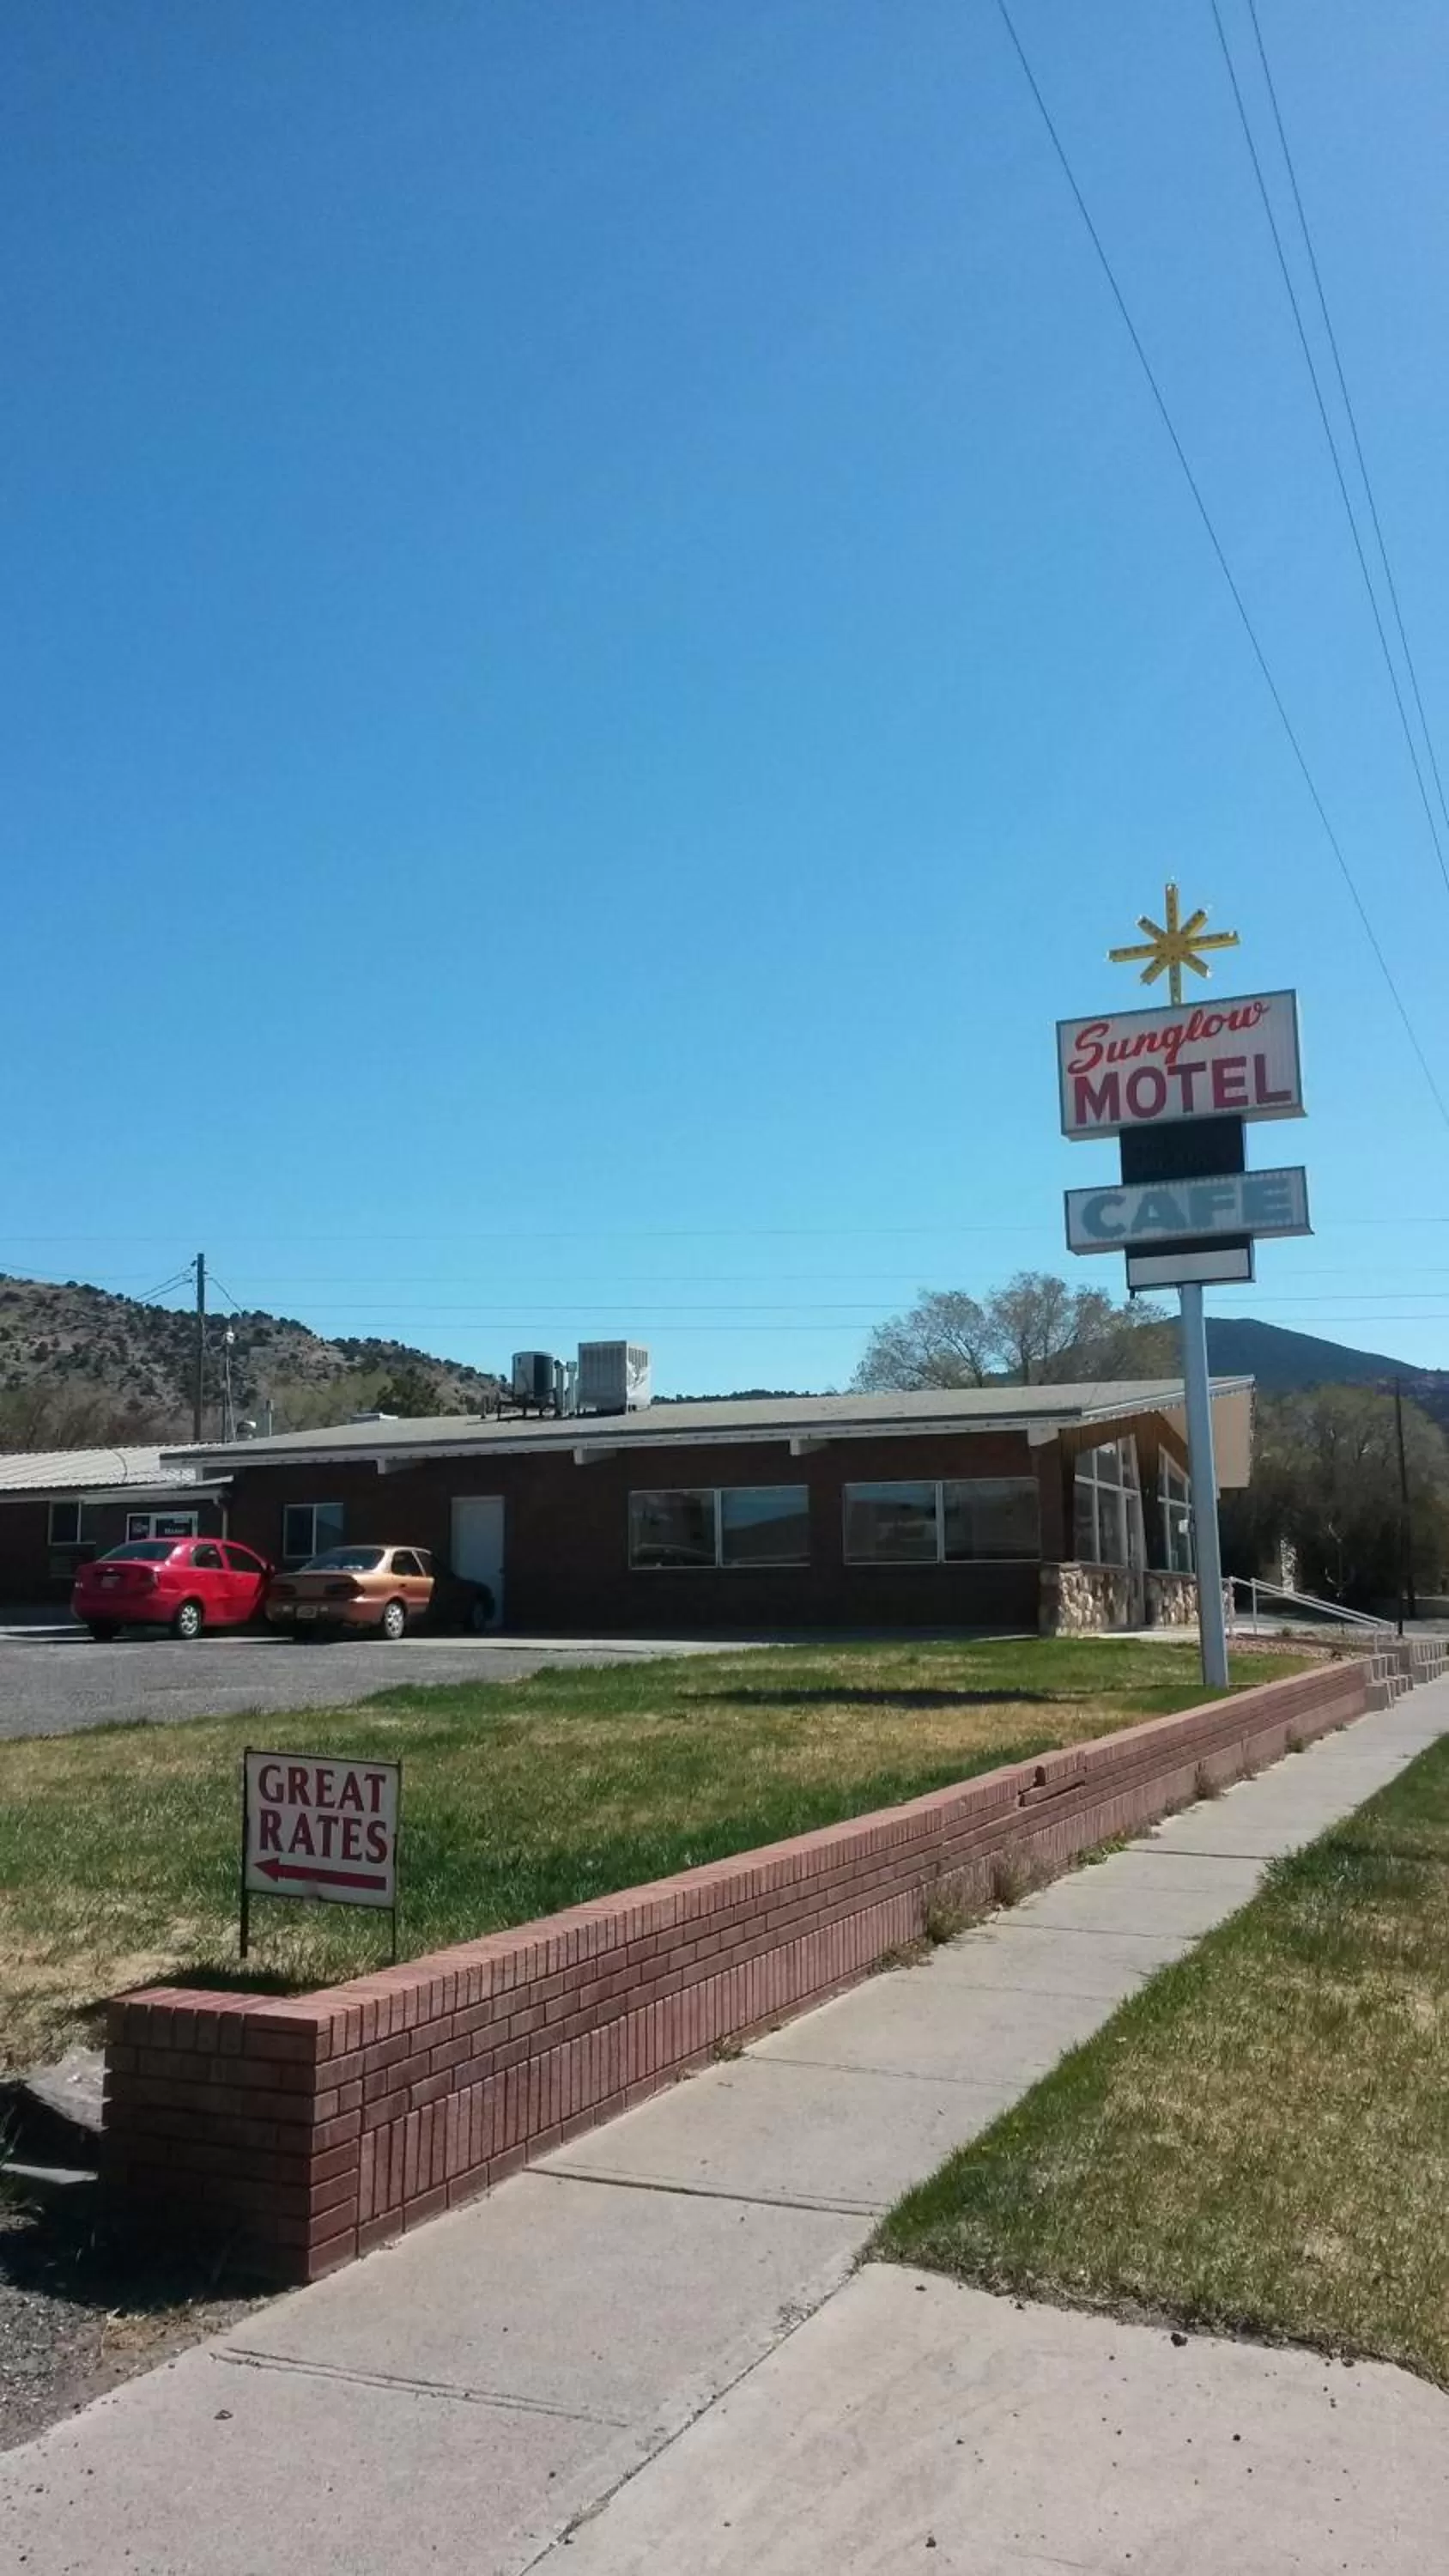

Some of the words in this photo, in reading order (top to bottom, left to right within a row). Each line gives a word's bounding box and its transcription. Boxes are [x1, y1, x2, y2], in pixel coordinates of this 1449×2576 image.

[1068, 1000, 1270, 1075] Sunglow
[1074, 1054, 1292, 1125] MOTEL
[1082, 1179, 1292, 1238] CAFE
[258, 1764, 386, 1813] GREAT
[259, 1807, 388, 1864] RATES
